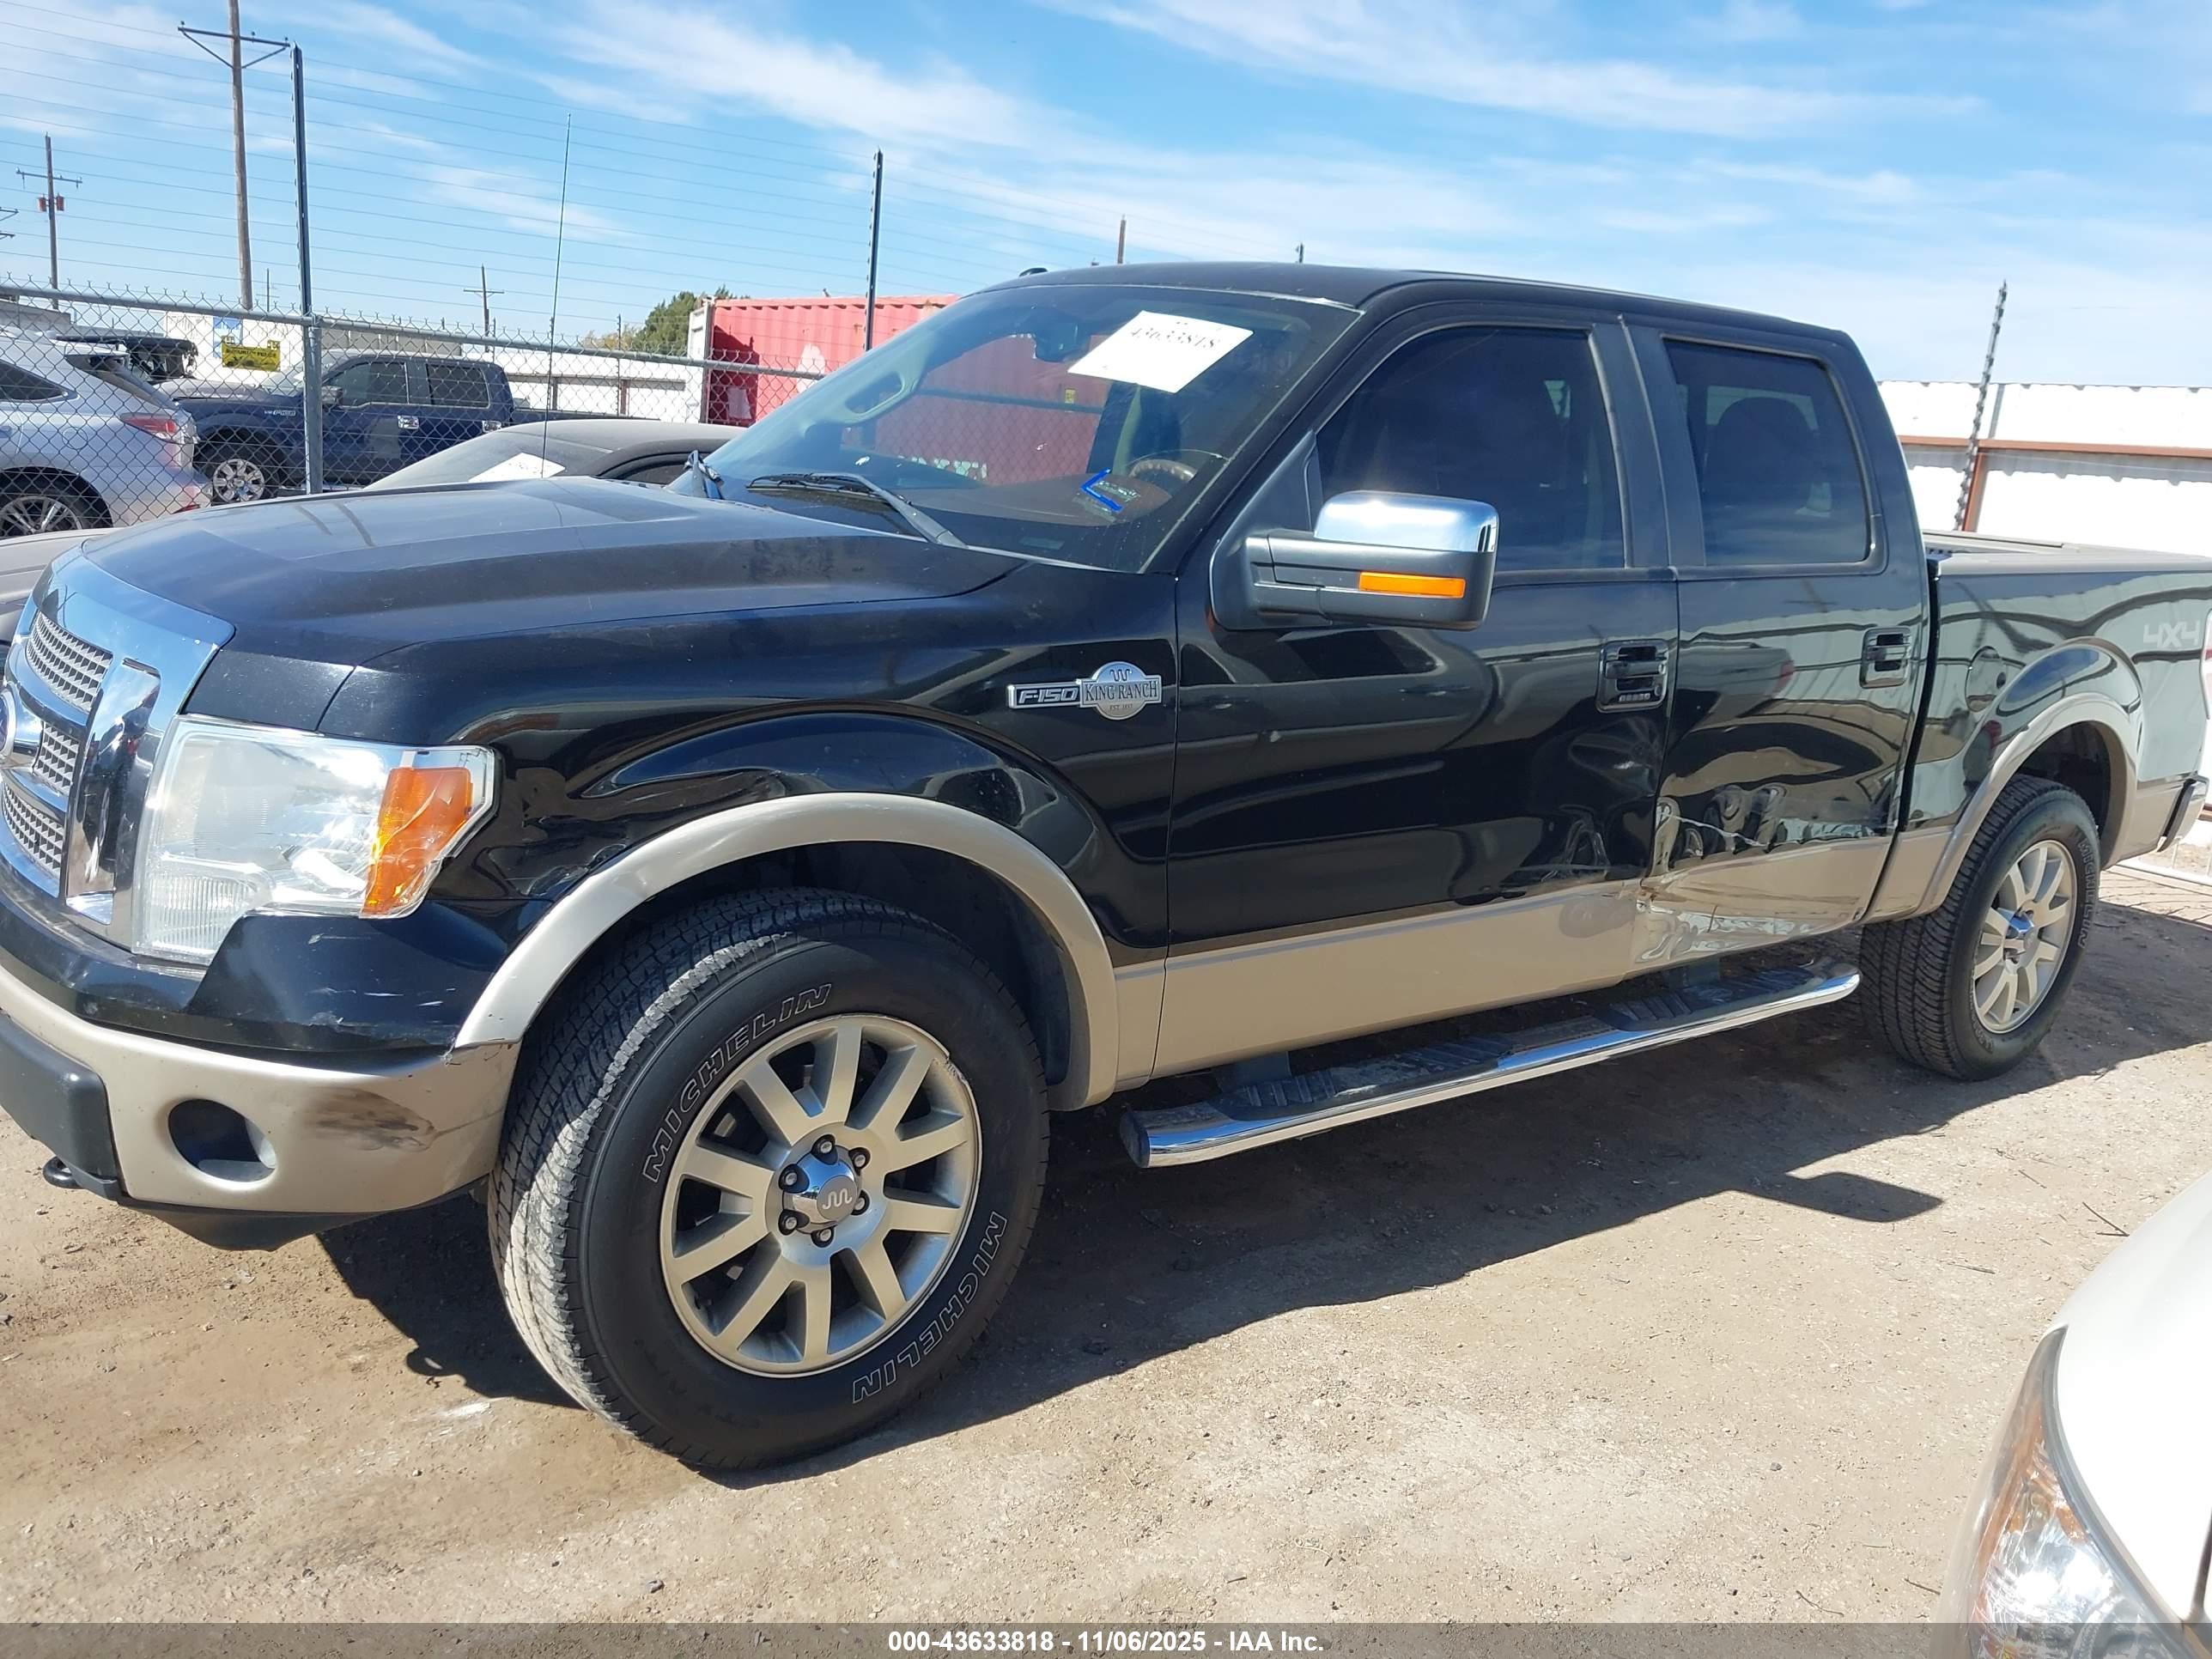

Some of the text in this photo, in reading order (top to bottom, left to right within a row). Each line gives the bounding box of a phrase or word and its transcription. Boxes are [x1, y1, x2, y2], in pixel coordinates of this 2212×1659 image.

[1018, 687, 1079, 704] F-150
[1085, 680, 1158, 702] KING RANCH
[2077, 836, 2096, 948] MICHELIN
[642, 983, 832, 1182] MICHELIN
[853, 1211, 1007, 1403] MICHELIN
